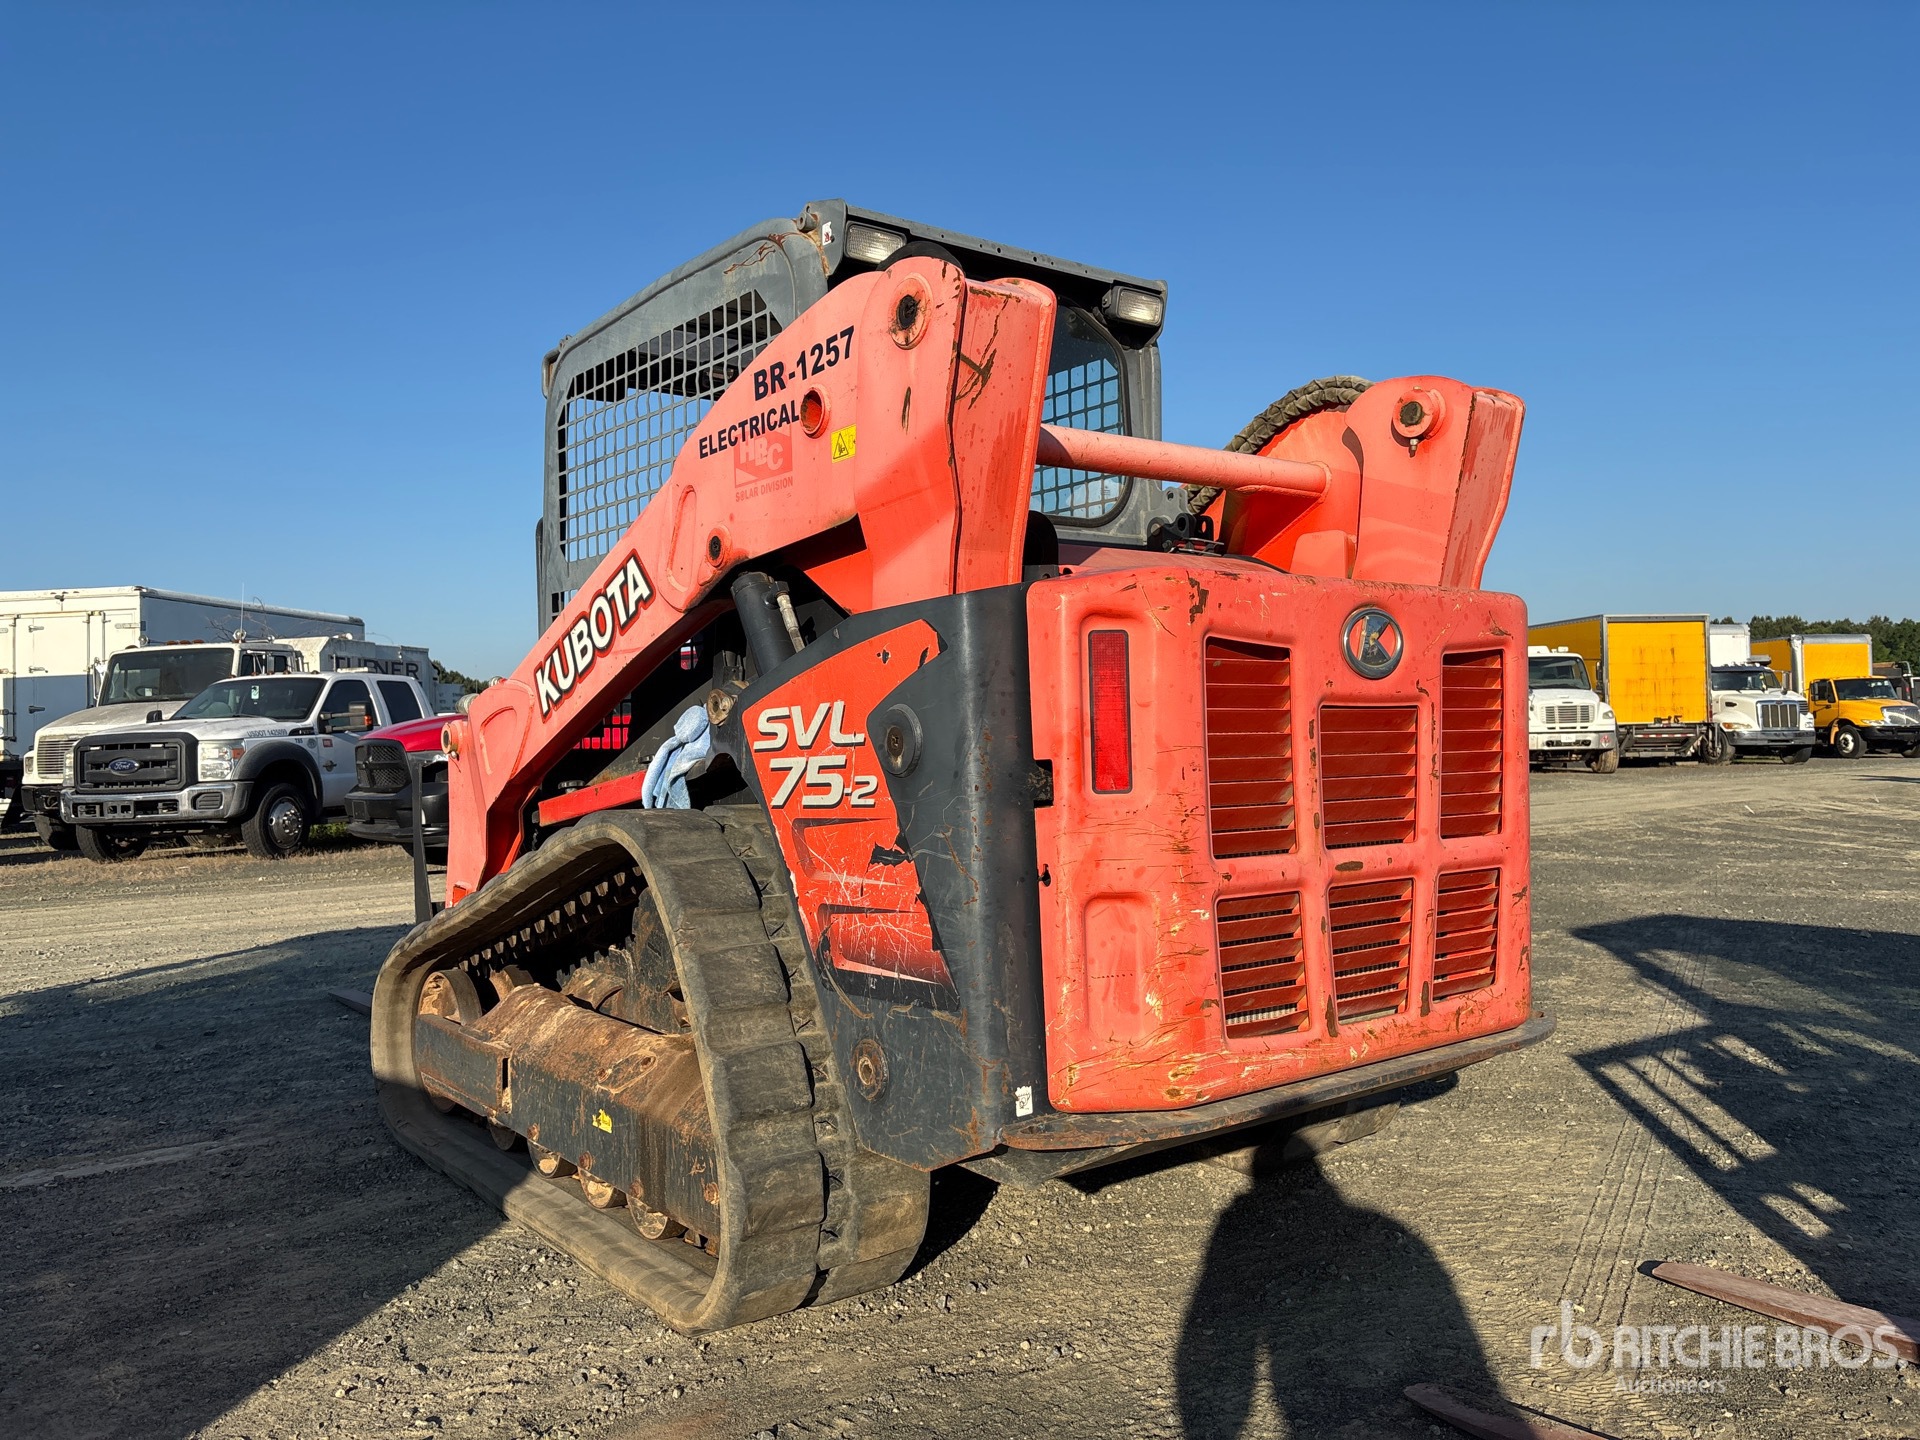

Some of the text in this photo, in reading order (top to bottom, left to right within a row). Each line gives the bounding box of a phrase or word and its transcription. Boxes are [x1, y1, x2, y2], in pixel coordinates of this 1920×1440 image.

[753, 325, 855, 401] BR-1257
[698, 400, 800, 459] ELECTRICAL
[739, 433, 784, 471] HBC
[735, 476, 793, 502] SOLAR DIVISION
[535, 555, 652, 716] KUBOTA
[753, 700, 866, 753] SVL
[769, 755, 879, 809] 75-2
